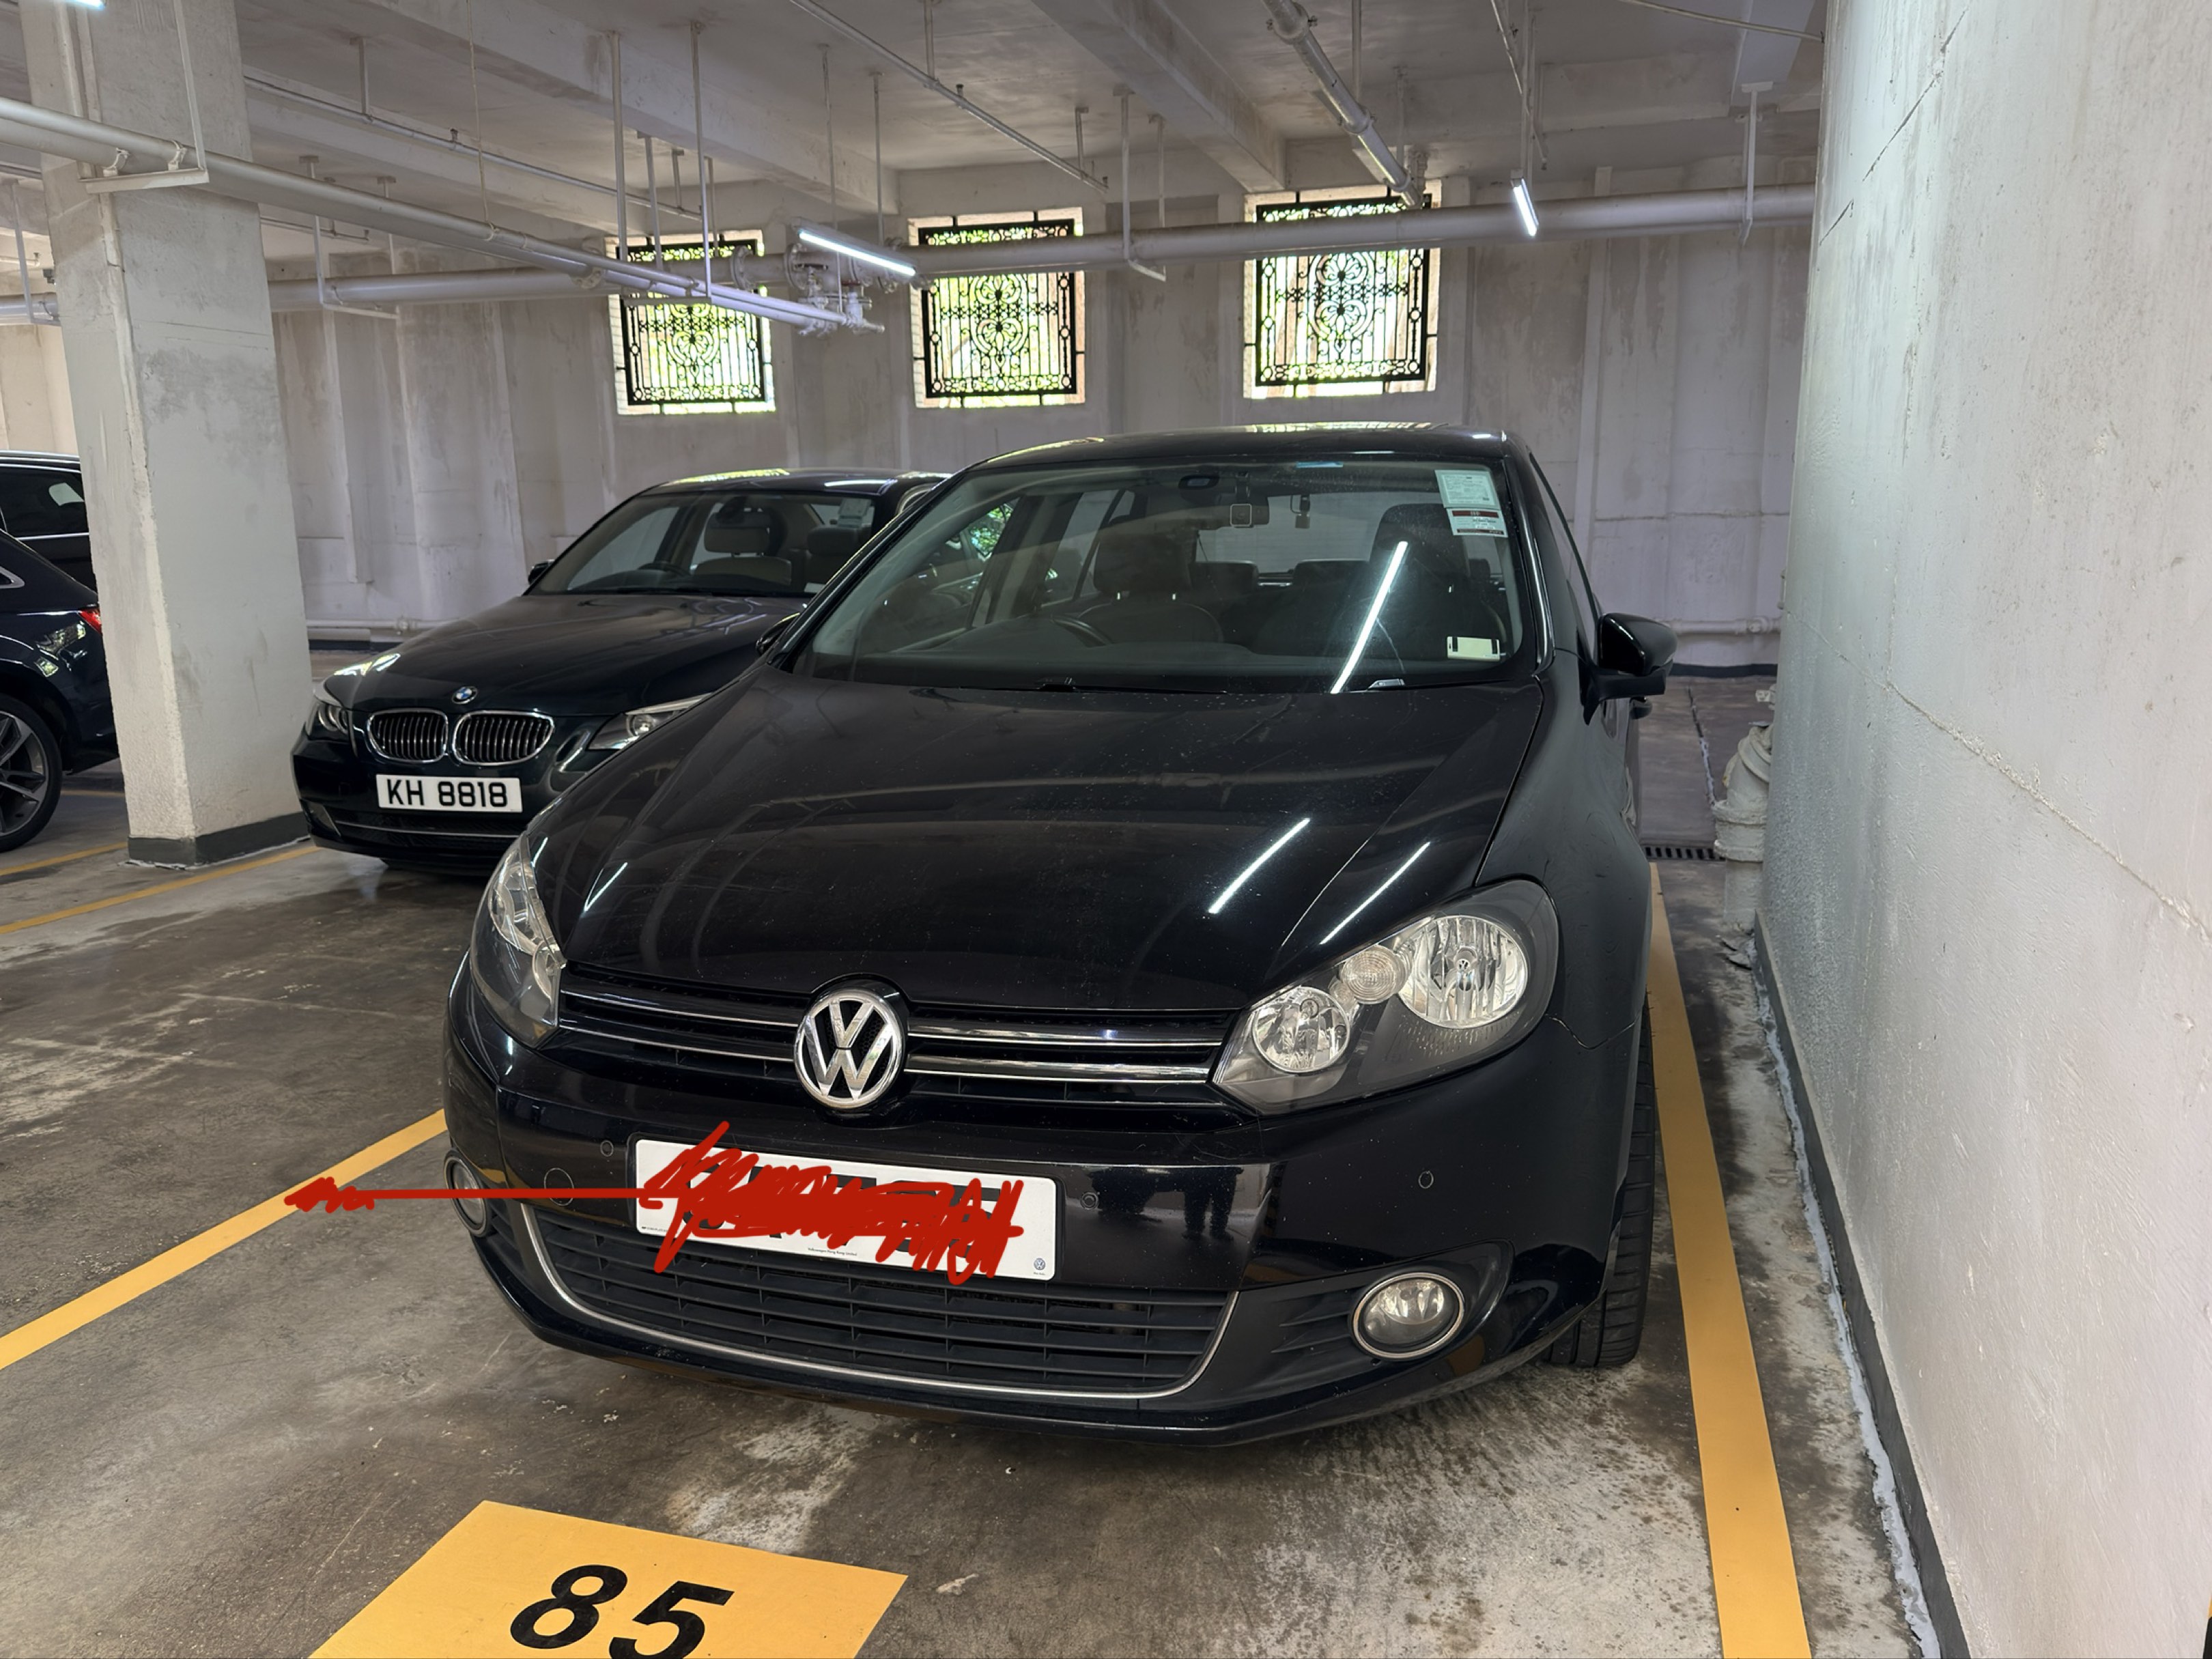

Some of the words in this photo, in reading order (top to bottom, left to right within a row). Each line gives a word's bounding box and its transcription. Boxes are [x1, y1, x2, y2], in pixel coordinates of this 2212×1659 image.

[386, 778, 425, 806] KH
[437, 781, 508, 808] 8818
[801, 997, 896, 1102] VW
[510, 1565, 735, 1659] 85
